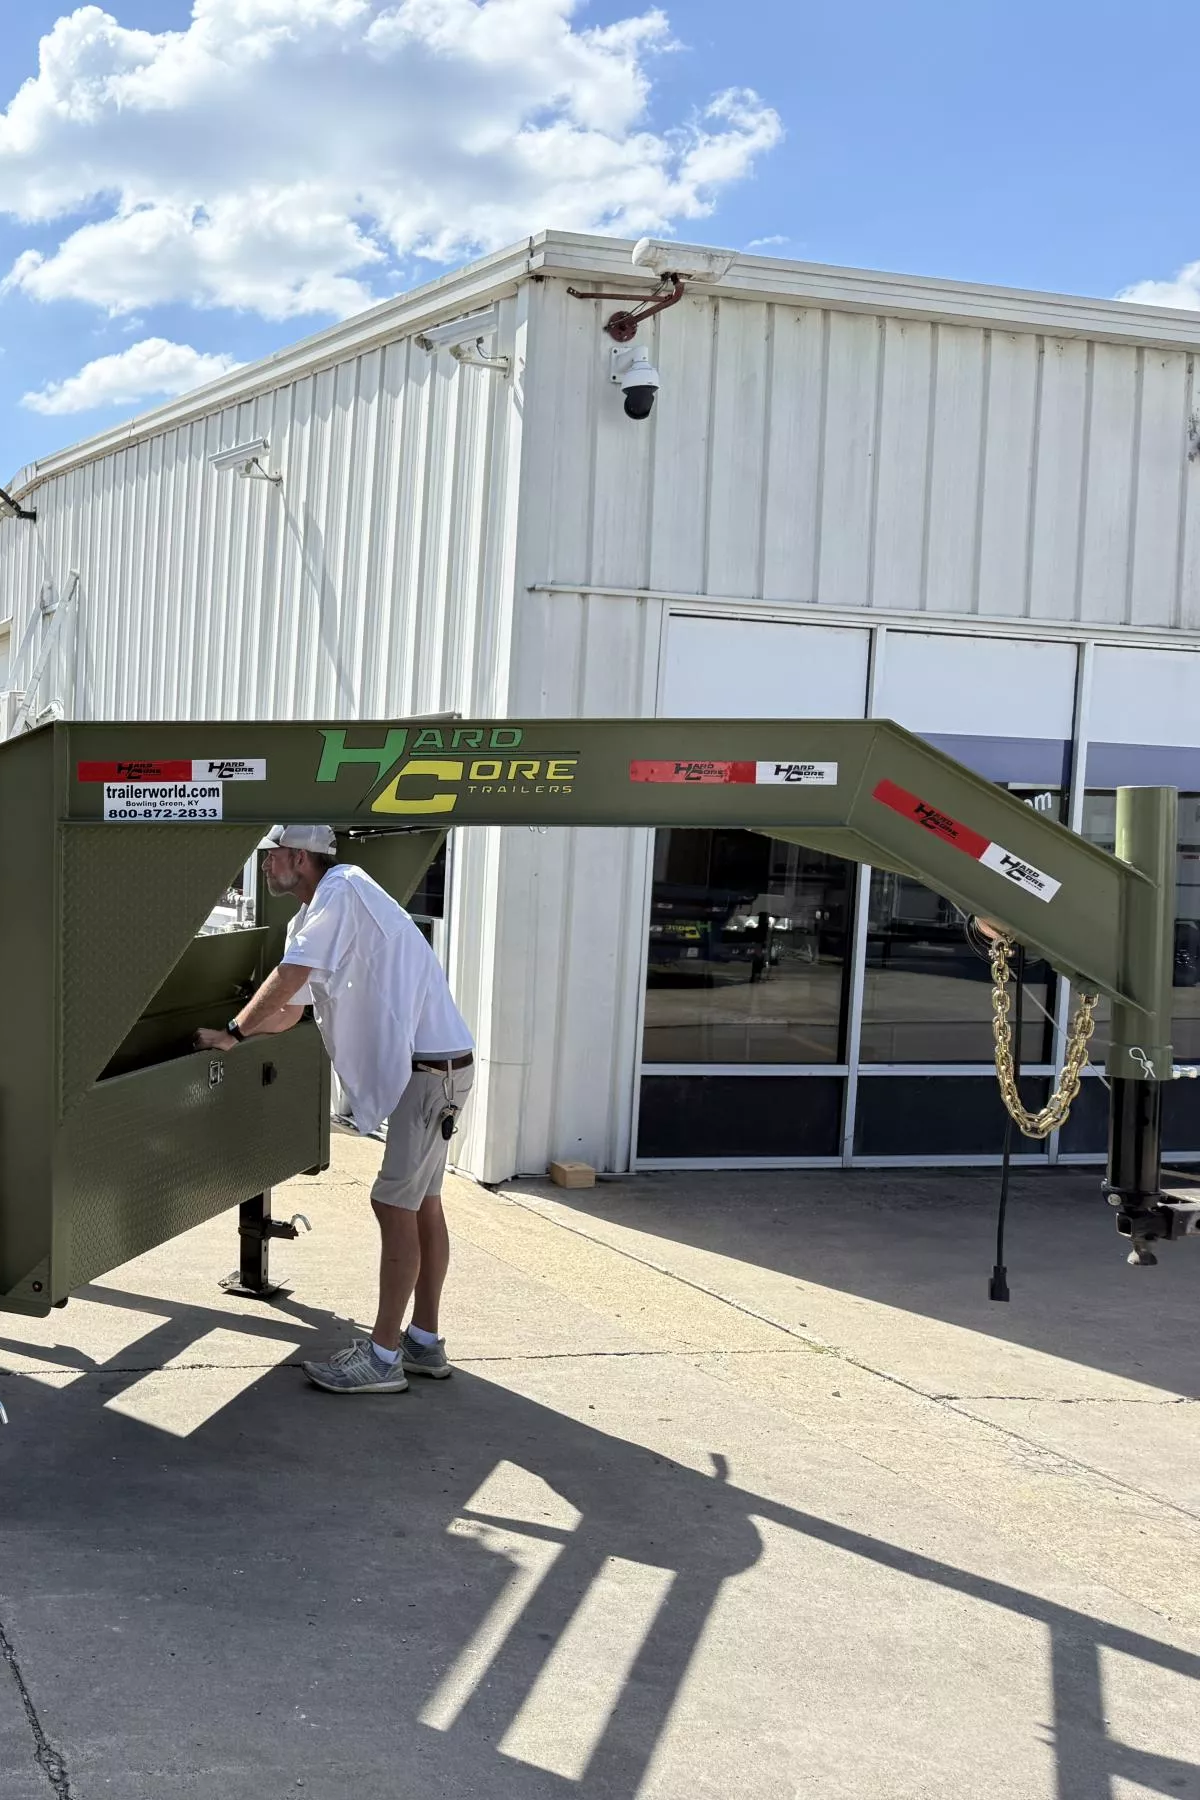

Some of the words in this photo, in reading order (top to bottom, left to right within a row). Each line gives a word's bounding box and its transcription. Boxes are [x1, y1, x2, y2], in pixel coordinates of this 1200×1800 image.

[315, 728, 523, 783] HARD
[207, 761, 246, 774] HARD
[218, 767, 255, 779] CORE
[774, 764, 815, 777] HARD
[106, 784, 220, 799] trailerworld.com
[371, 760, 578, 815] CORE
[468, 785, 573, 794] TRAILERS
[125, 800, 157, 808] Bowling
[108, 808, 218, 819] 800-872-2833
[1000, 854, 1040, 878] HARD
[1005, 867, 1046, 890] CORE
